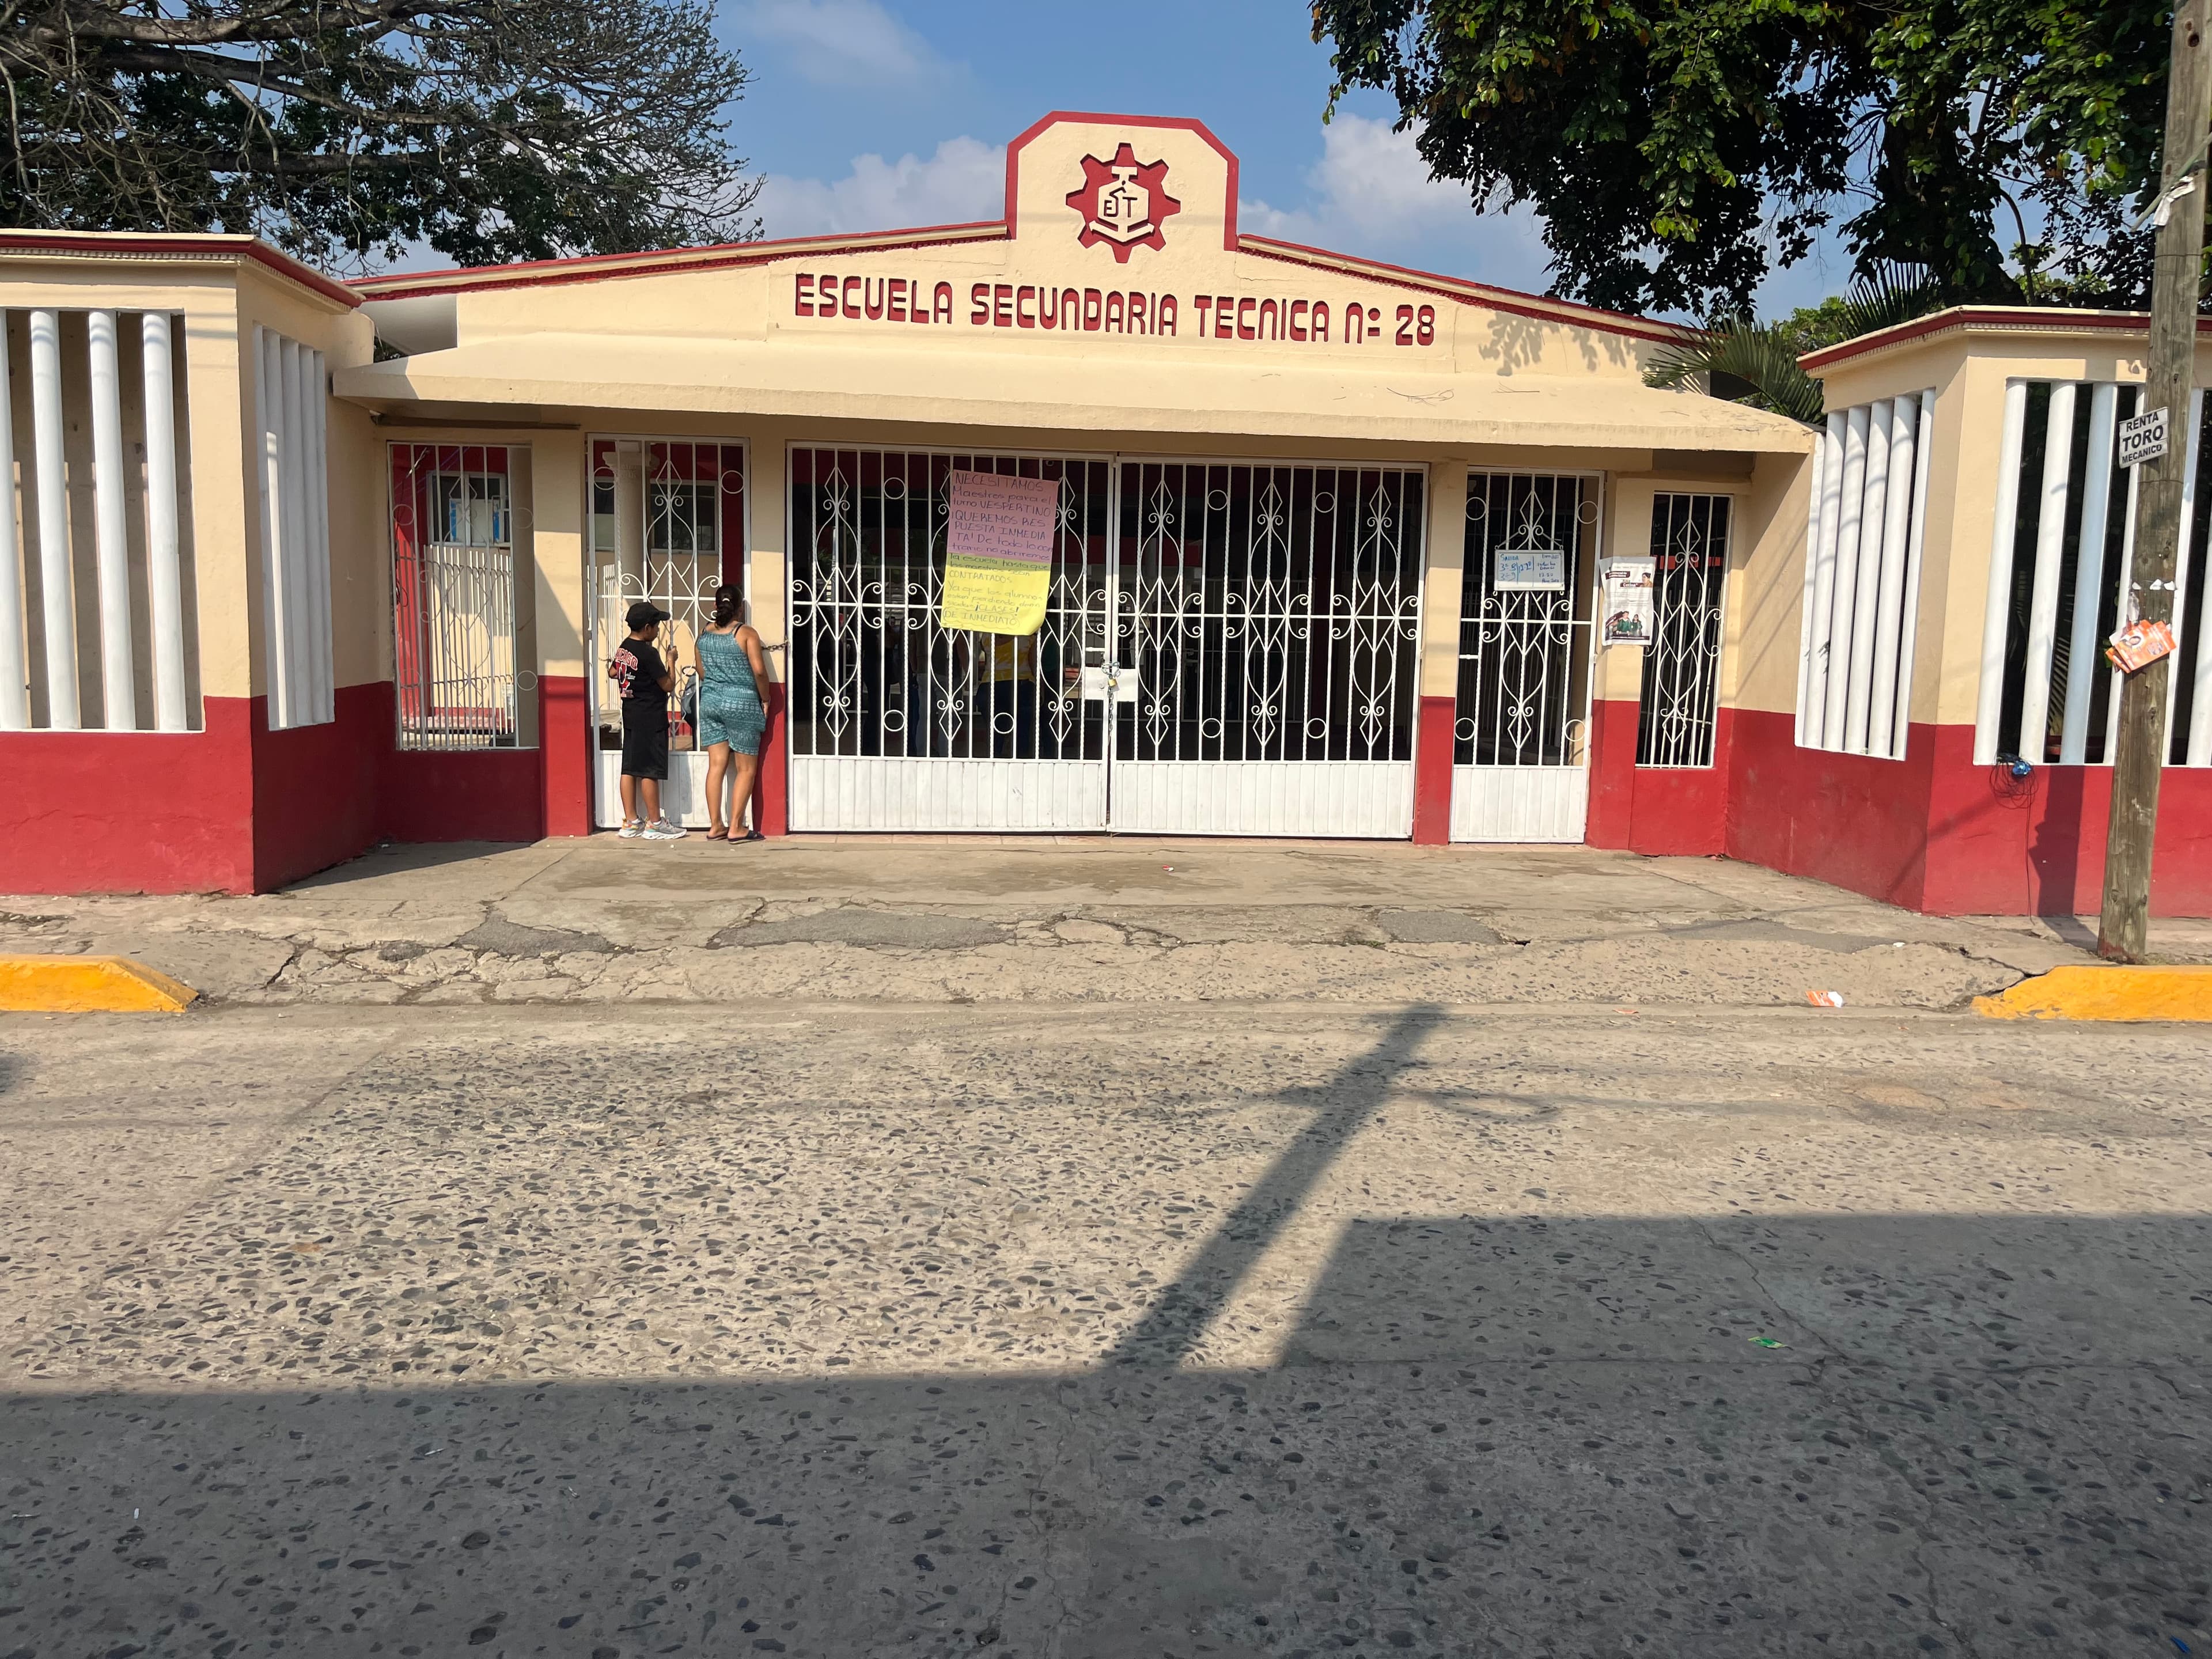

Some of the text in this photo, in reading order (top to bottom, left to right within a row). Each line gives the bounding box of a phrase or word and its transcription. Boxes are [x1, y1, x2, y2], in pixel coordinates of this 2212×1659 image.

[795, 273, 953, 324] ESCUELA
[971, 283, 1177, 337] SECUNDARIA
[1194, 295, 1330, 343] TECNICA
[1395, 304, 1435, 346] 28
[2126, 412, 2158, 432] RENTA
[2123, 425, 2164, 452] TORO
[2122, 444, 2162, 464] MECANICO
[955, 472, 1044, 492] NECESITAMOS
[953, 486, 1051, 505] Maestros para el
[980, 501, 1051, 517] VESPERTINO
[955, 521, 1046, 540] PUESTA INMEDIA
[978, 534, 993, 544] De
[950, 552, 960, 560] la
[963, 555, 998, 565] escuela
[1002, 560, 1029, 568] hasta
[949, 570, 1013, 584] CONTRATADOS
[948, 580, 1043, 600] Ya que los alumnos
[945, 610, 1018, 626] DE INMEDIATO
